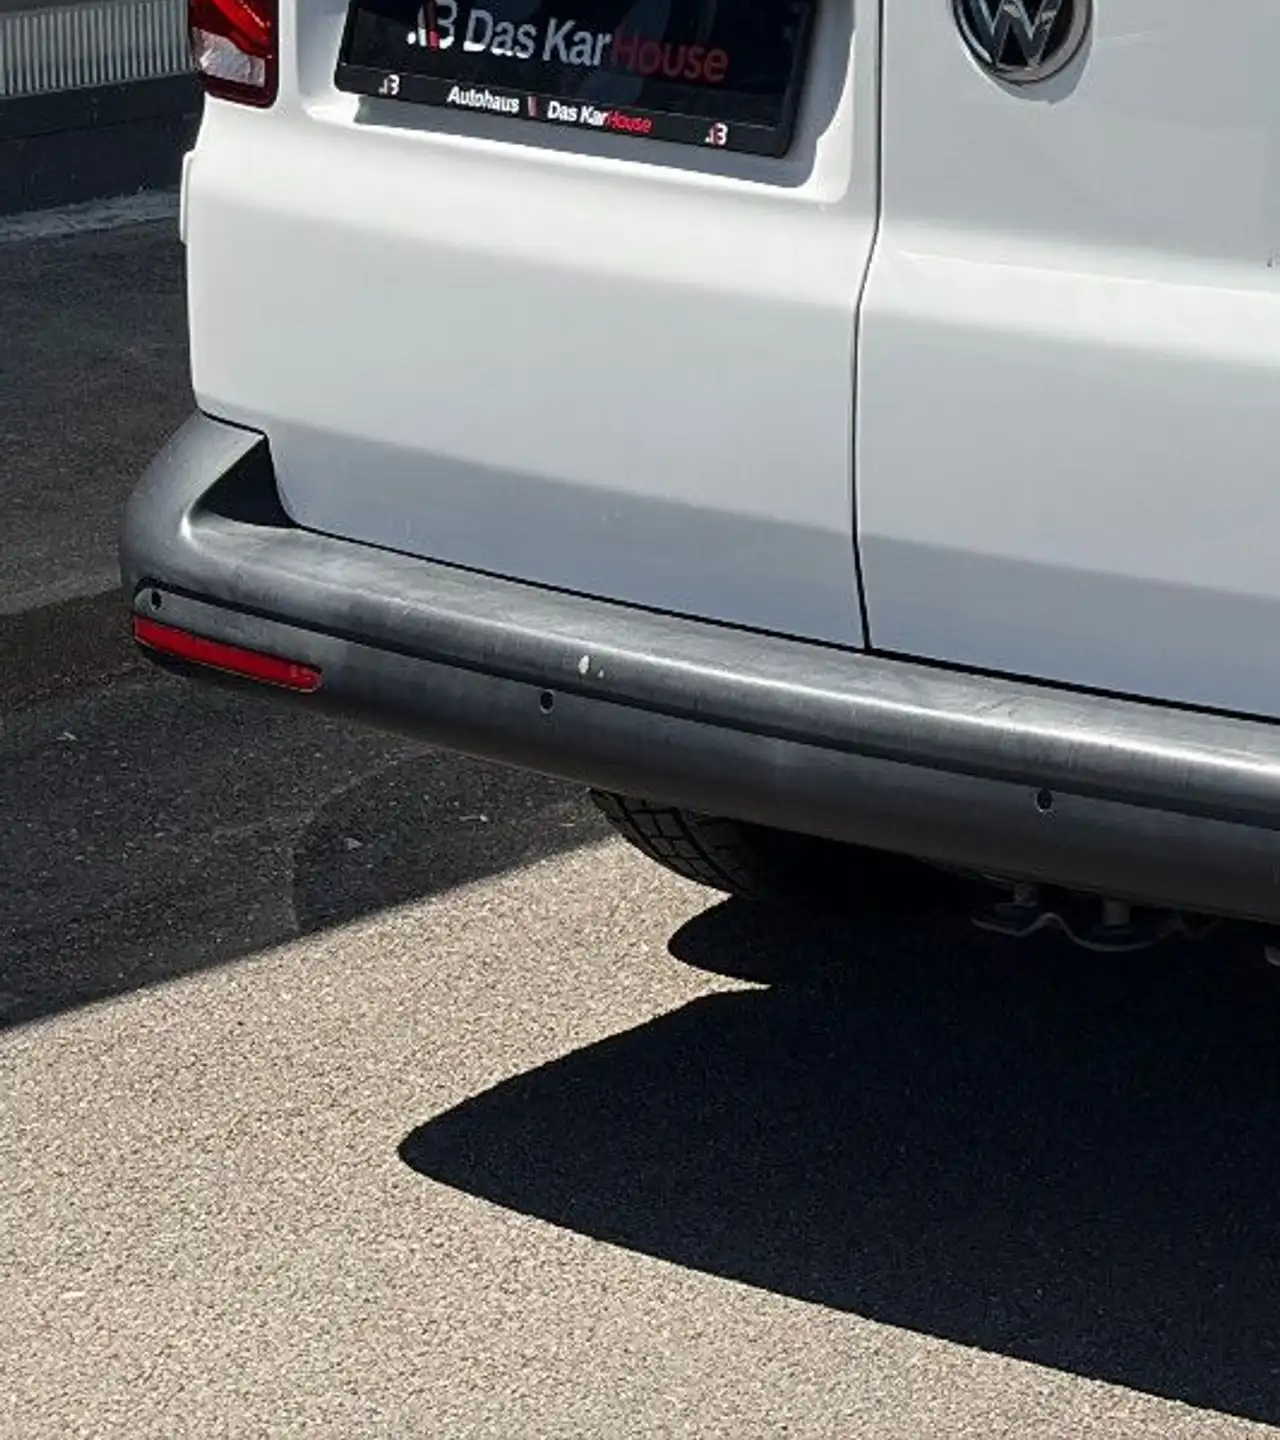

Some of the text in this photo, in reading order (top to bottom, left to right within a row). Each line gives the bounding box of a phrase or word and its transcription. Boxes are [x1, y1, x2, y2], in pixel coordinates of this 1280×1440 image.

[463, 8, 537, 59] Das
[541, 16, 729, 82] KarHouse
[447, 85, 520, 114] Autohaus
[548, 101, 577, 122] Das
